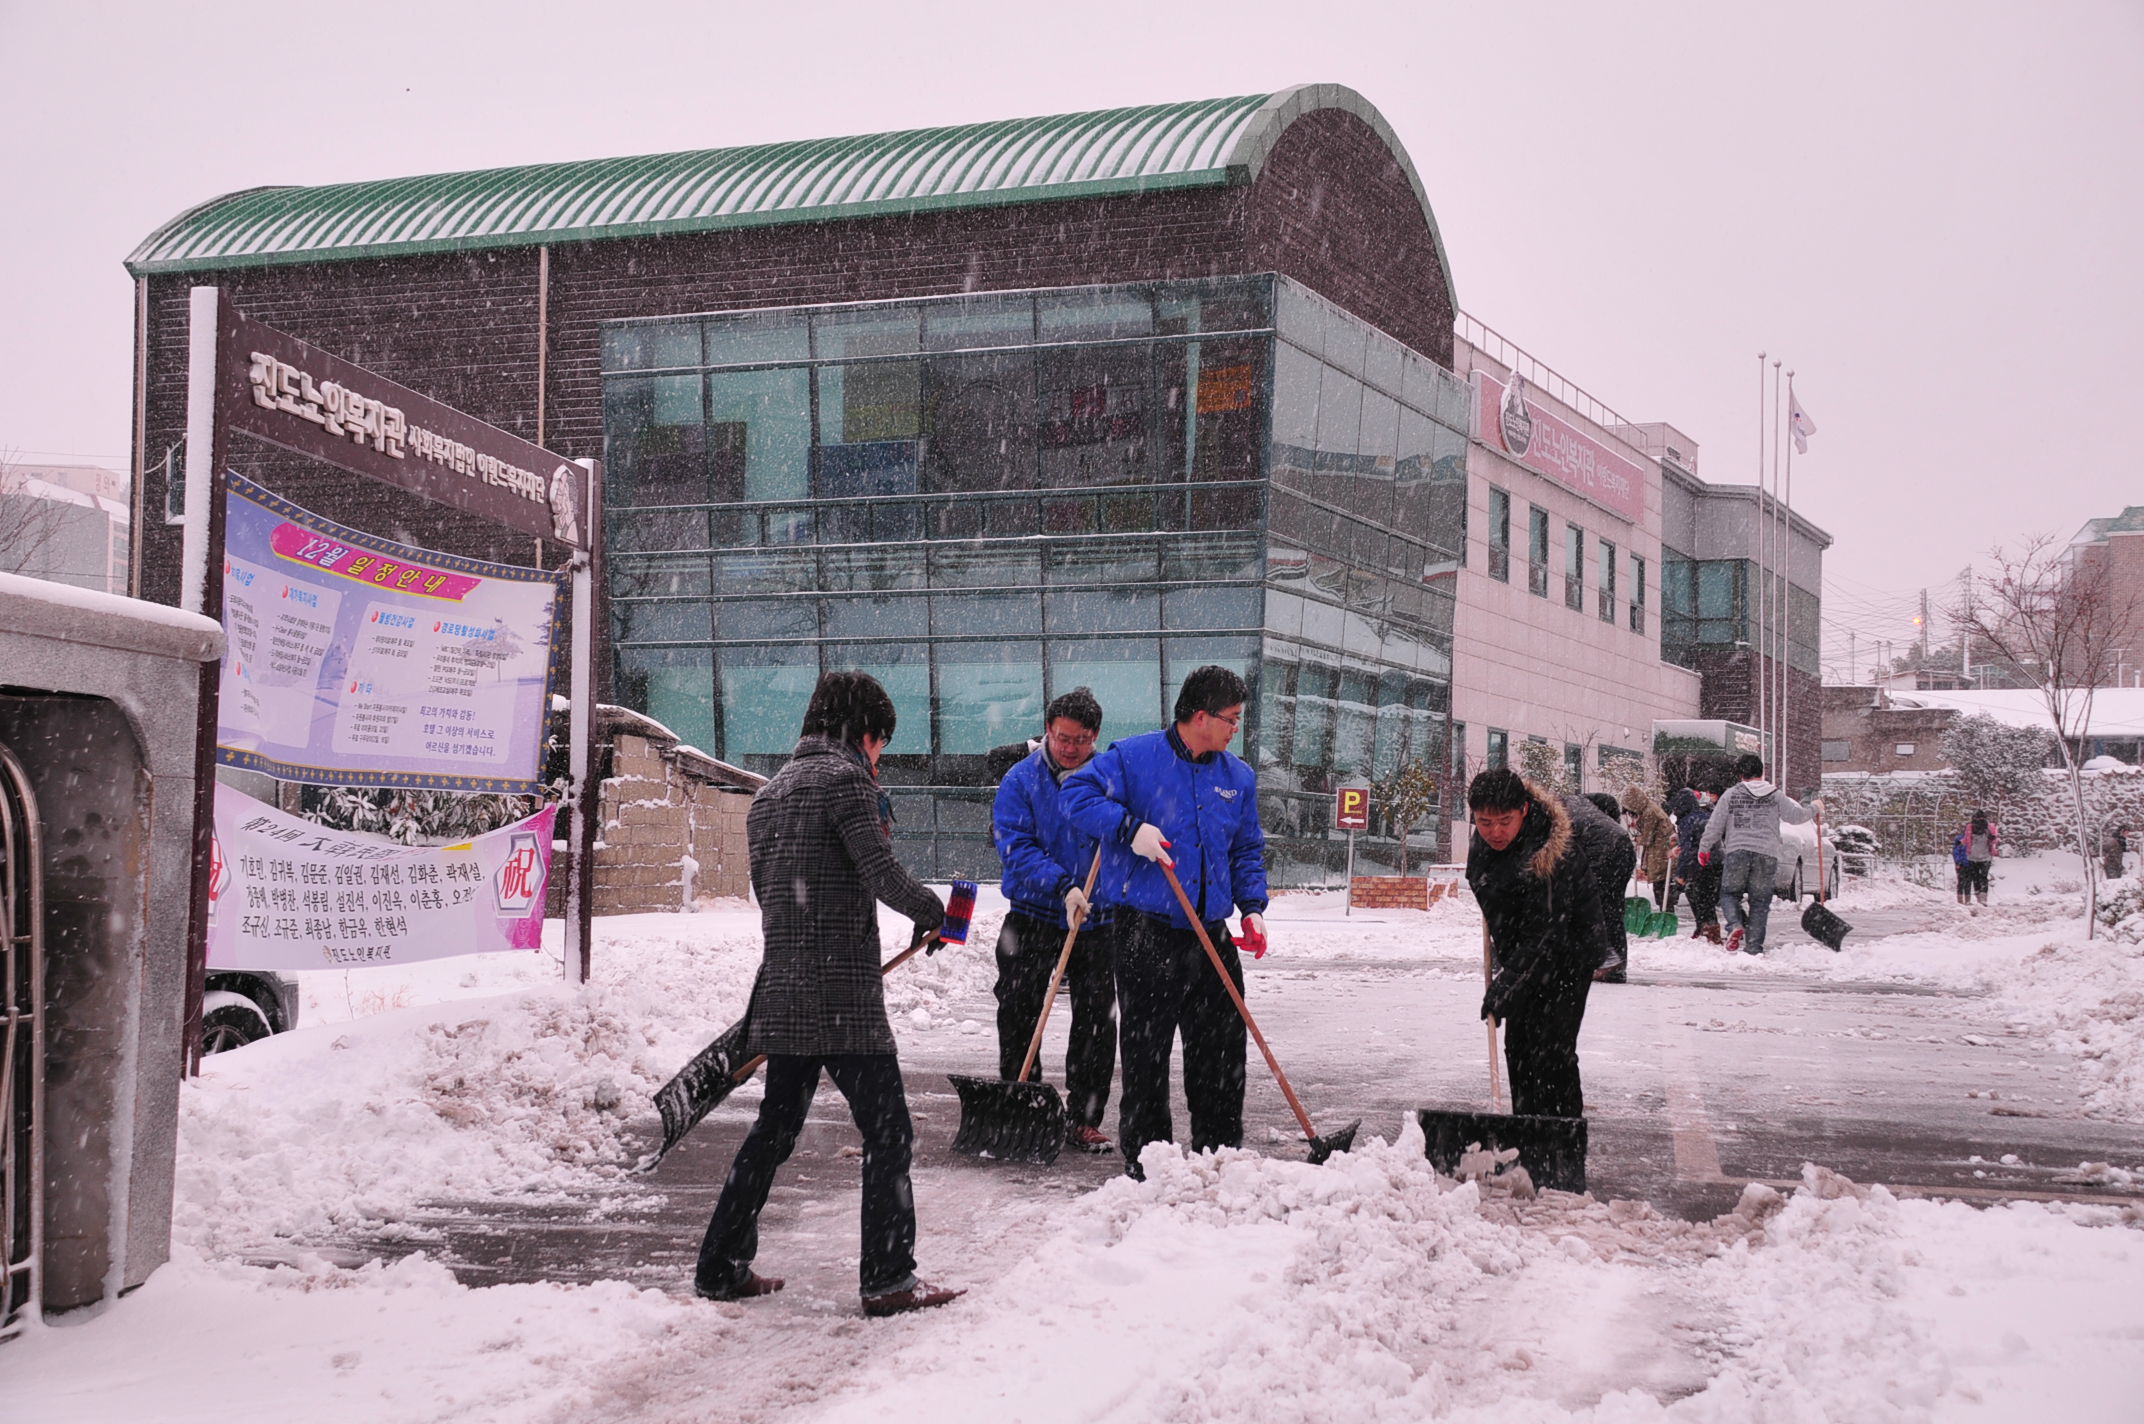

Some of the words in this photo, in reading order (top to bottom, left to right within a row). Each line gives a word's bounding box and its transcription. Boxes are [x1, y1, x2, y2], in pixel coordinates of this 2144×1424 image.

[250, 351, 406, 459] 진도노인복지관
[408, 424, 475, 477] 사회복지법인
[477, 453, 545, 504] 이랜드복지재단
[295, 538, 349, 567] 12월
[1344, 791, 1361, 813] P
[374, 915, 408, 936] 한현석
